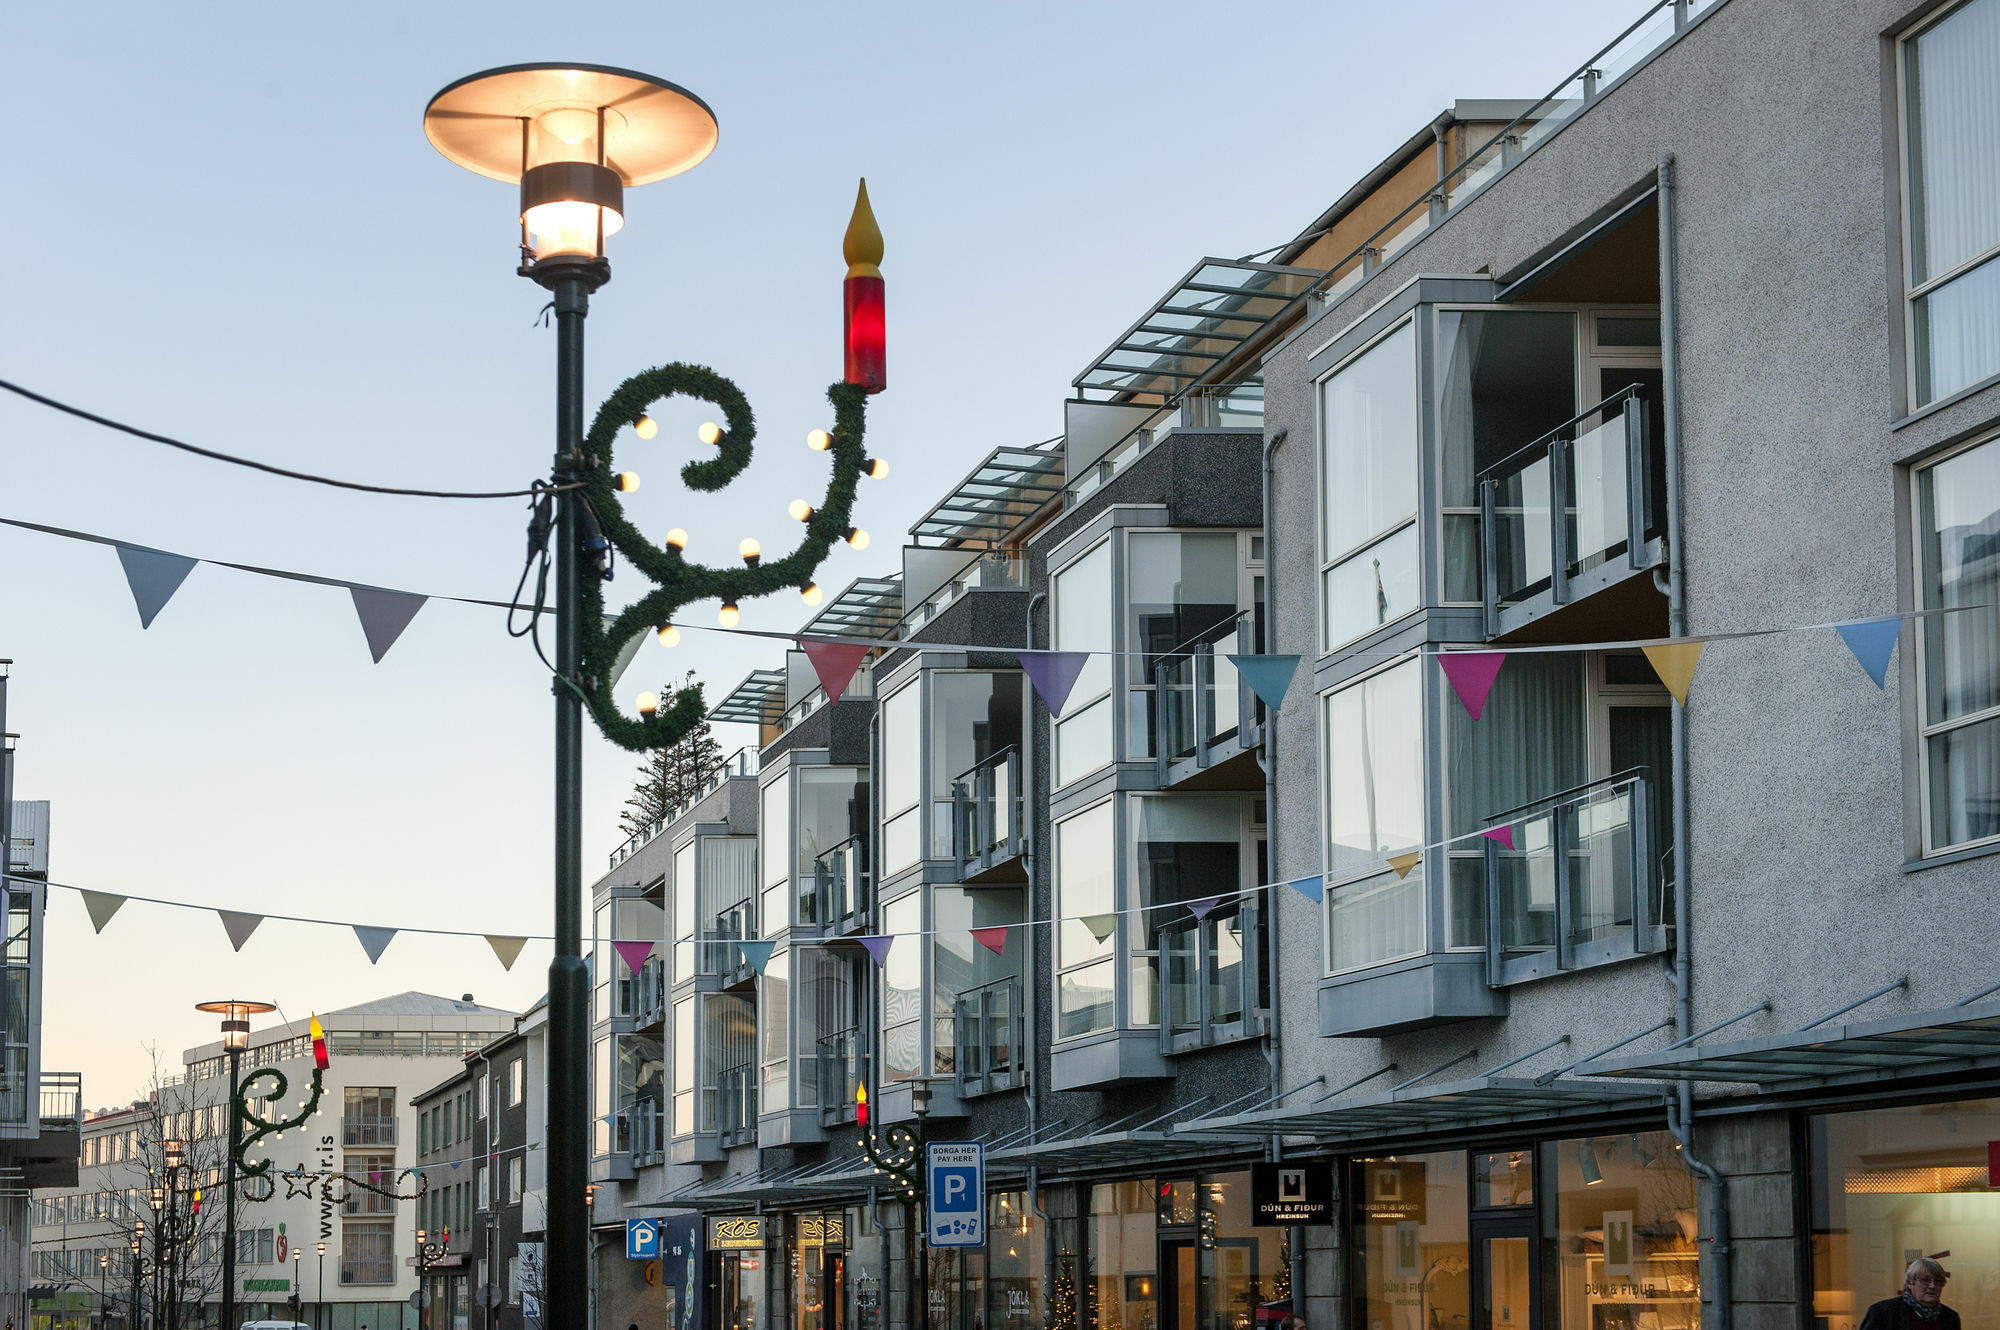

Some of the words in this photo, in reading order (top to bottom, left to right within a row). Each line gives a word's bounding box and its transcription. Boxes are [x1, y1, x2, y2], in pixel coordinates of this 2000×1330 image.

[316, 1135, 334, 1239] wwwr.is
[1260, 1203, 1282, 1212] DÚN
[1284, 1204, 1292, 1212] &
[1294, 1204, 1324, 1212] FIÐUR
[635, 1229, 654, 1252] P
[1584, 1280, 1607, 1295] DÚN
[1610, 1283, 1618, 1295] &
[1006, 1287, 1030, 1319] JÖKLA
